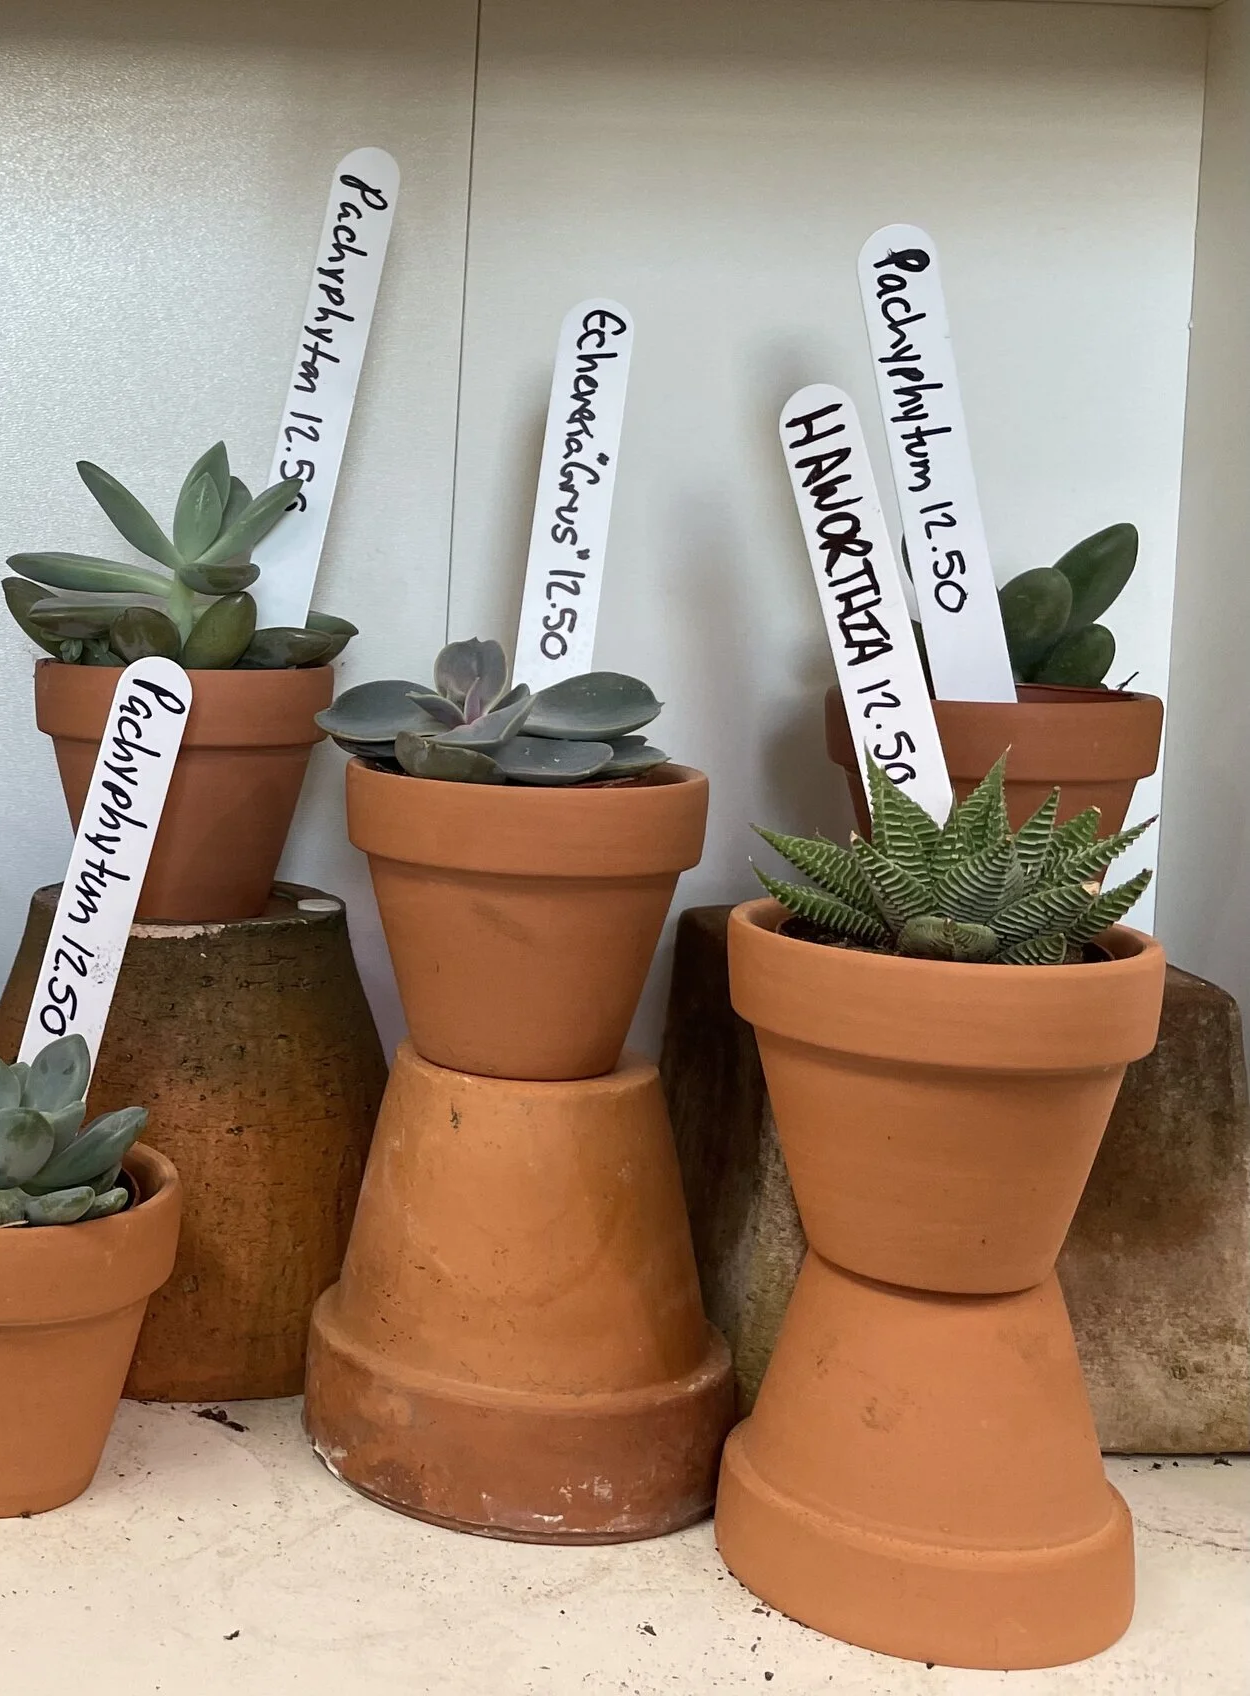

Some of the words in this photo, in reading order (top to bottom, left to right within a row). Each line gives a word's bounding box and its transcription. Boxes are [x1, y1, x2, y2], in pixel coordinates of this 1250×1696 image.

[873, 247, 952, 493] Pachyphytum
[919, 501, 968, 614] 12.50
[540, 569, 586, 660] 12.50
[786, 402, 894, 667] HAWORTHIA
[857, 679, 917, 785] 12.50
[68, 678, 186, 925] Pachyphytum
[40, 934, 95, 1037] 12.50
